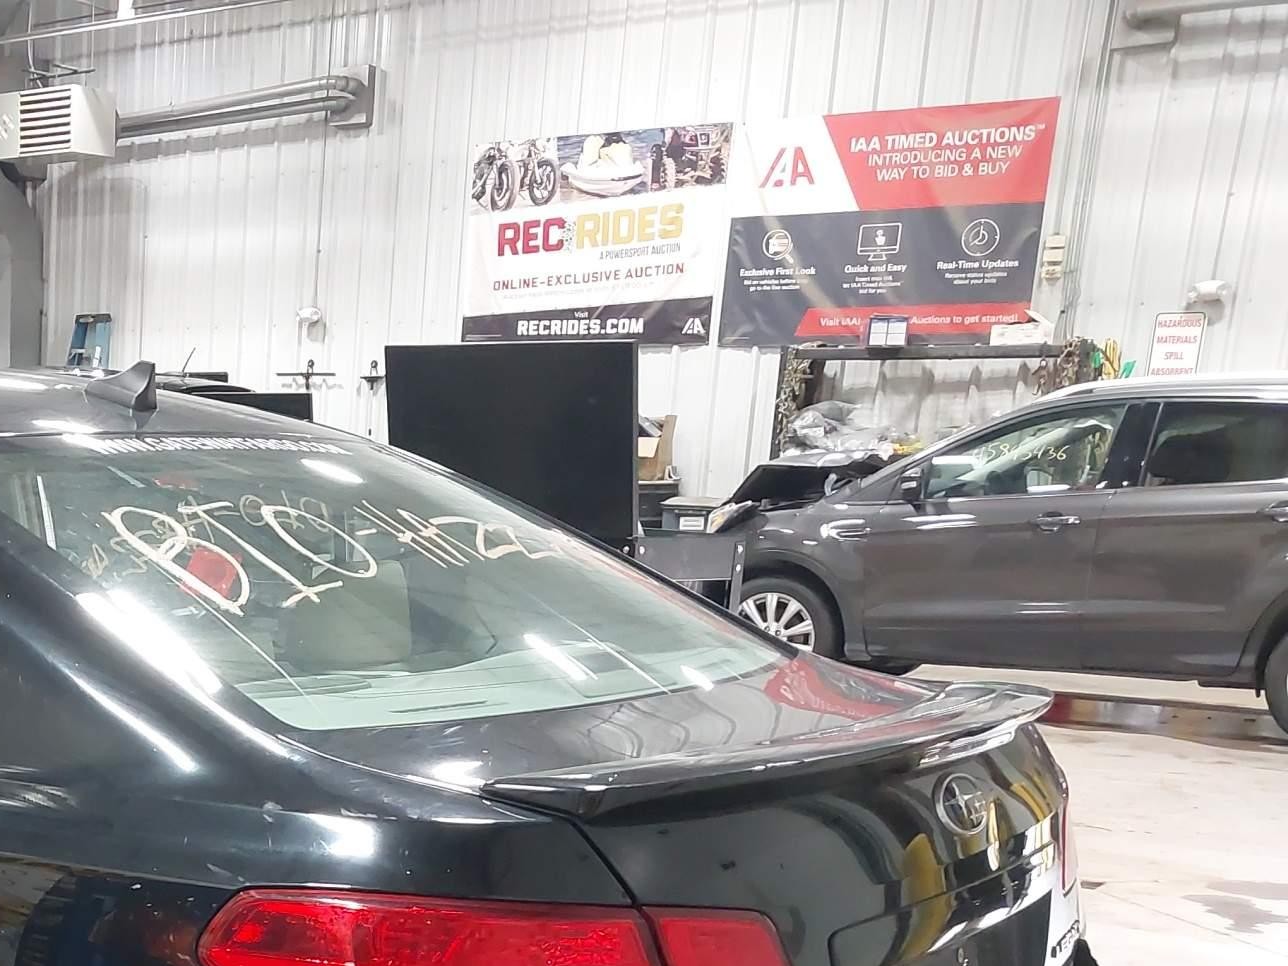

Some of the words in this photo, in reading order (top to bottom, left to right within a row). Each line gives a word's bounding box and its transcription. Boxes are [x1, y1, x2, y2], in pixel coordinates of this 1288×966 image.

[850, 137, 881, 153] IAA
[885, 132, 937, 150] TIMED
[868, 148, 966, 166] INTRODUCING
[970, 148, 981, 161] A
[986, 144, 1024, 159] NEW
[876, 166, 908, 182] WAY
[912, 165, 929, 178] TO
[934, 163, 958, 178] BID
[962, 163, 973, 176] &
[978, 161, 1010, 175] BUY
[576, 203, 684, 250] RIDES
[605, 246, 650, 260] POWERSPORT
[650, 242, 681, 256] AUCTION
[844, 264, 869, 273] Quick
[870, 264, 887, 273] and
[887, 263, 908, 273] Easy
[936, 260, 980, 270] Real-Time
[981, 259, 1020, 270] Updates
[493, 269, 621, 291] ONLINE-EXCLUSIVE
[625, 262, 685, 280] AUCTION
[740, 268, 775, 277] Exclusive
[775, 267, 794, 276] First
[795, 266, 816, 275] Look
[820, 317, 839, 326] Visit
[911, 315, 950, 324] Auctions
[952, 315, 962, 323] to
[964, 315, 979, 324] get
[1158, 318, 1201, 328] HAZARDOUS
[517, 318, 644, 336] RECRIDES.COM
[1156, 335, 1198, 344] MATERIALS
[1164, 351, 1184, 360] SPILL
[1150, 367, 1194, 376] ABSORBENT
